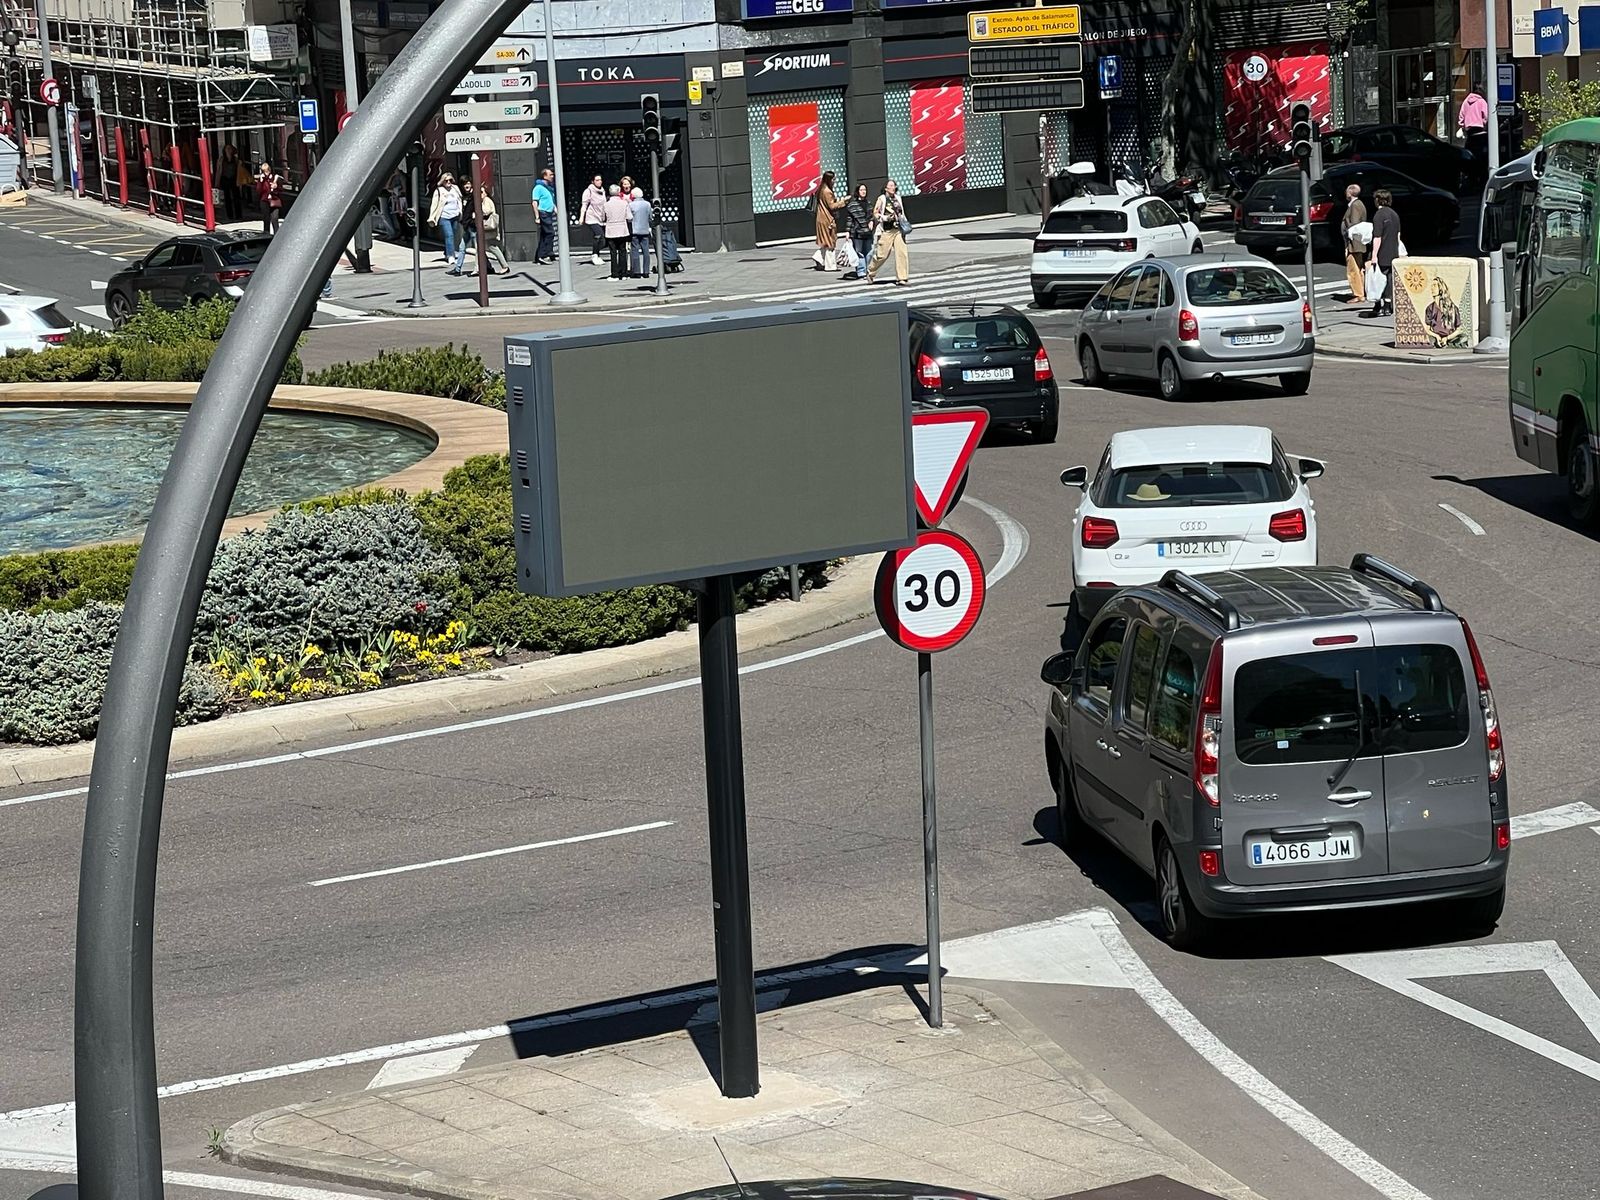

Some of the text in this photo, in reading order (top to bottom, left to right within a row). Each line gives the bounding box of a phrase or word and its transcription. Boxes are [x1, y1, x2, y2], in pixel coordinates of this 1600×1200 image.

[1041, 12, 1075, 20] Salamanca
[992, 22, 1075, 34] ESTADO DEL TRÁFICO
[1107, 29, 1119, 39] DE
[1121, 27, 1147, 37] JUEGO
[1540, 24, 1562, 38] BBVA
[754, 52, 831, 77] SPORTIUM
[1246, 63, 1264, 74] 30
[577, 66, 635, 81] TOKA
[448, 109, 469, 118] TORO
[450, 137, 481, 146] ZAMORA
[971, 369, 992, 379] 1525
[1168, 540, 1227, 554] 1302 KLY
[904, 570, 961, 612] 30
[1266, 840, 1351, 861] 4066 JJM
